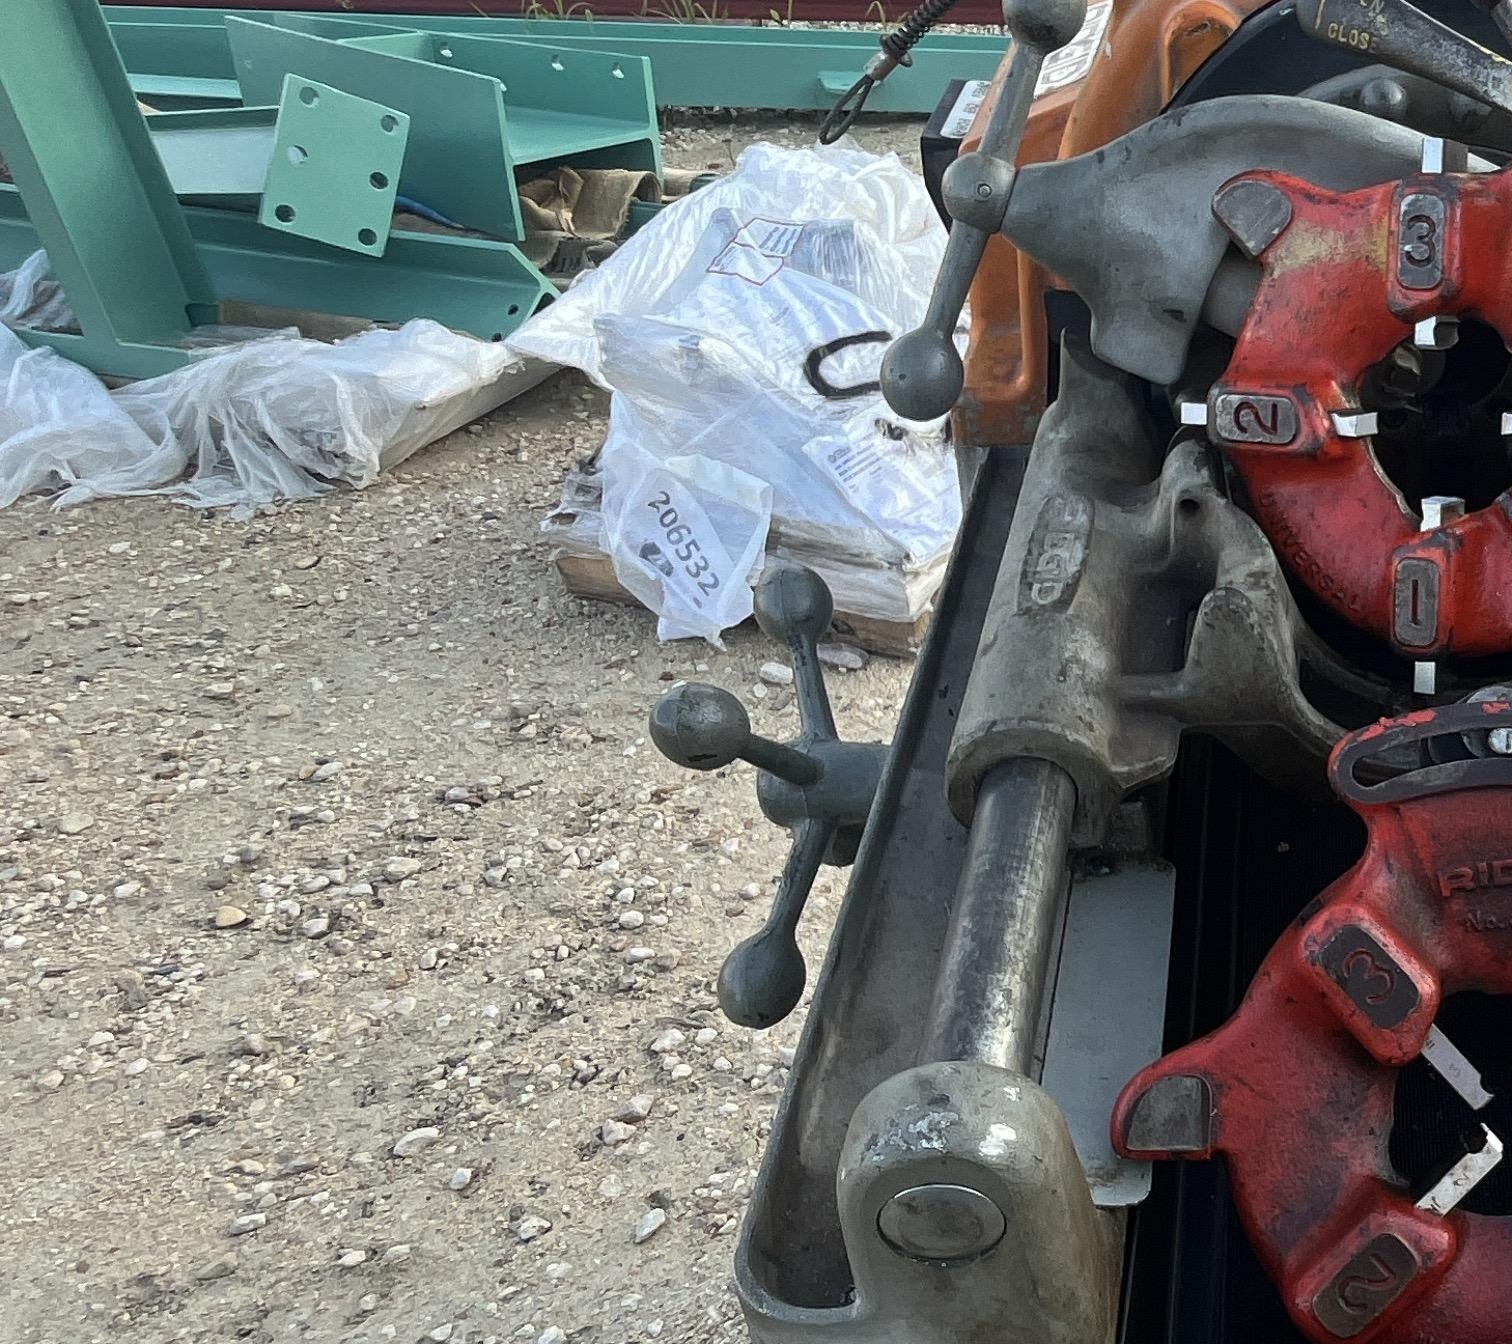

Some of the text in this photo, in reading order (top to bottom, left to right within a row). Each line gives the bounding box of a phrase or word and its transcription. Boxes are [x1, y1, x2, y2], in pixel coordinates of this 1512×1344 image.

[1406, 213, 1437, 267] 3
[1235, 402, 1279, 434] 2
[647, 490, 720, 597] 206532
[1346, 948, 1395, 1005] 3
[1336, 1252, 1397, 1313] 2
